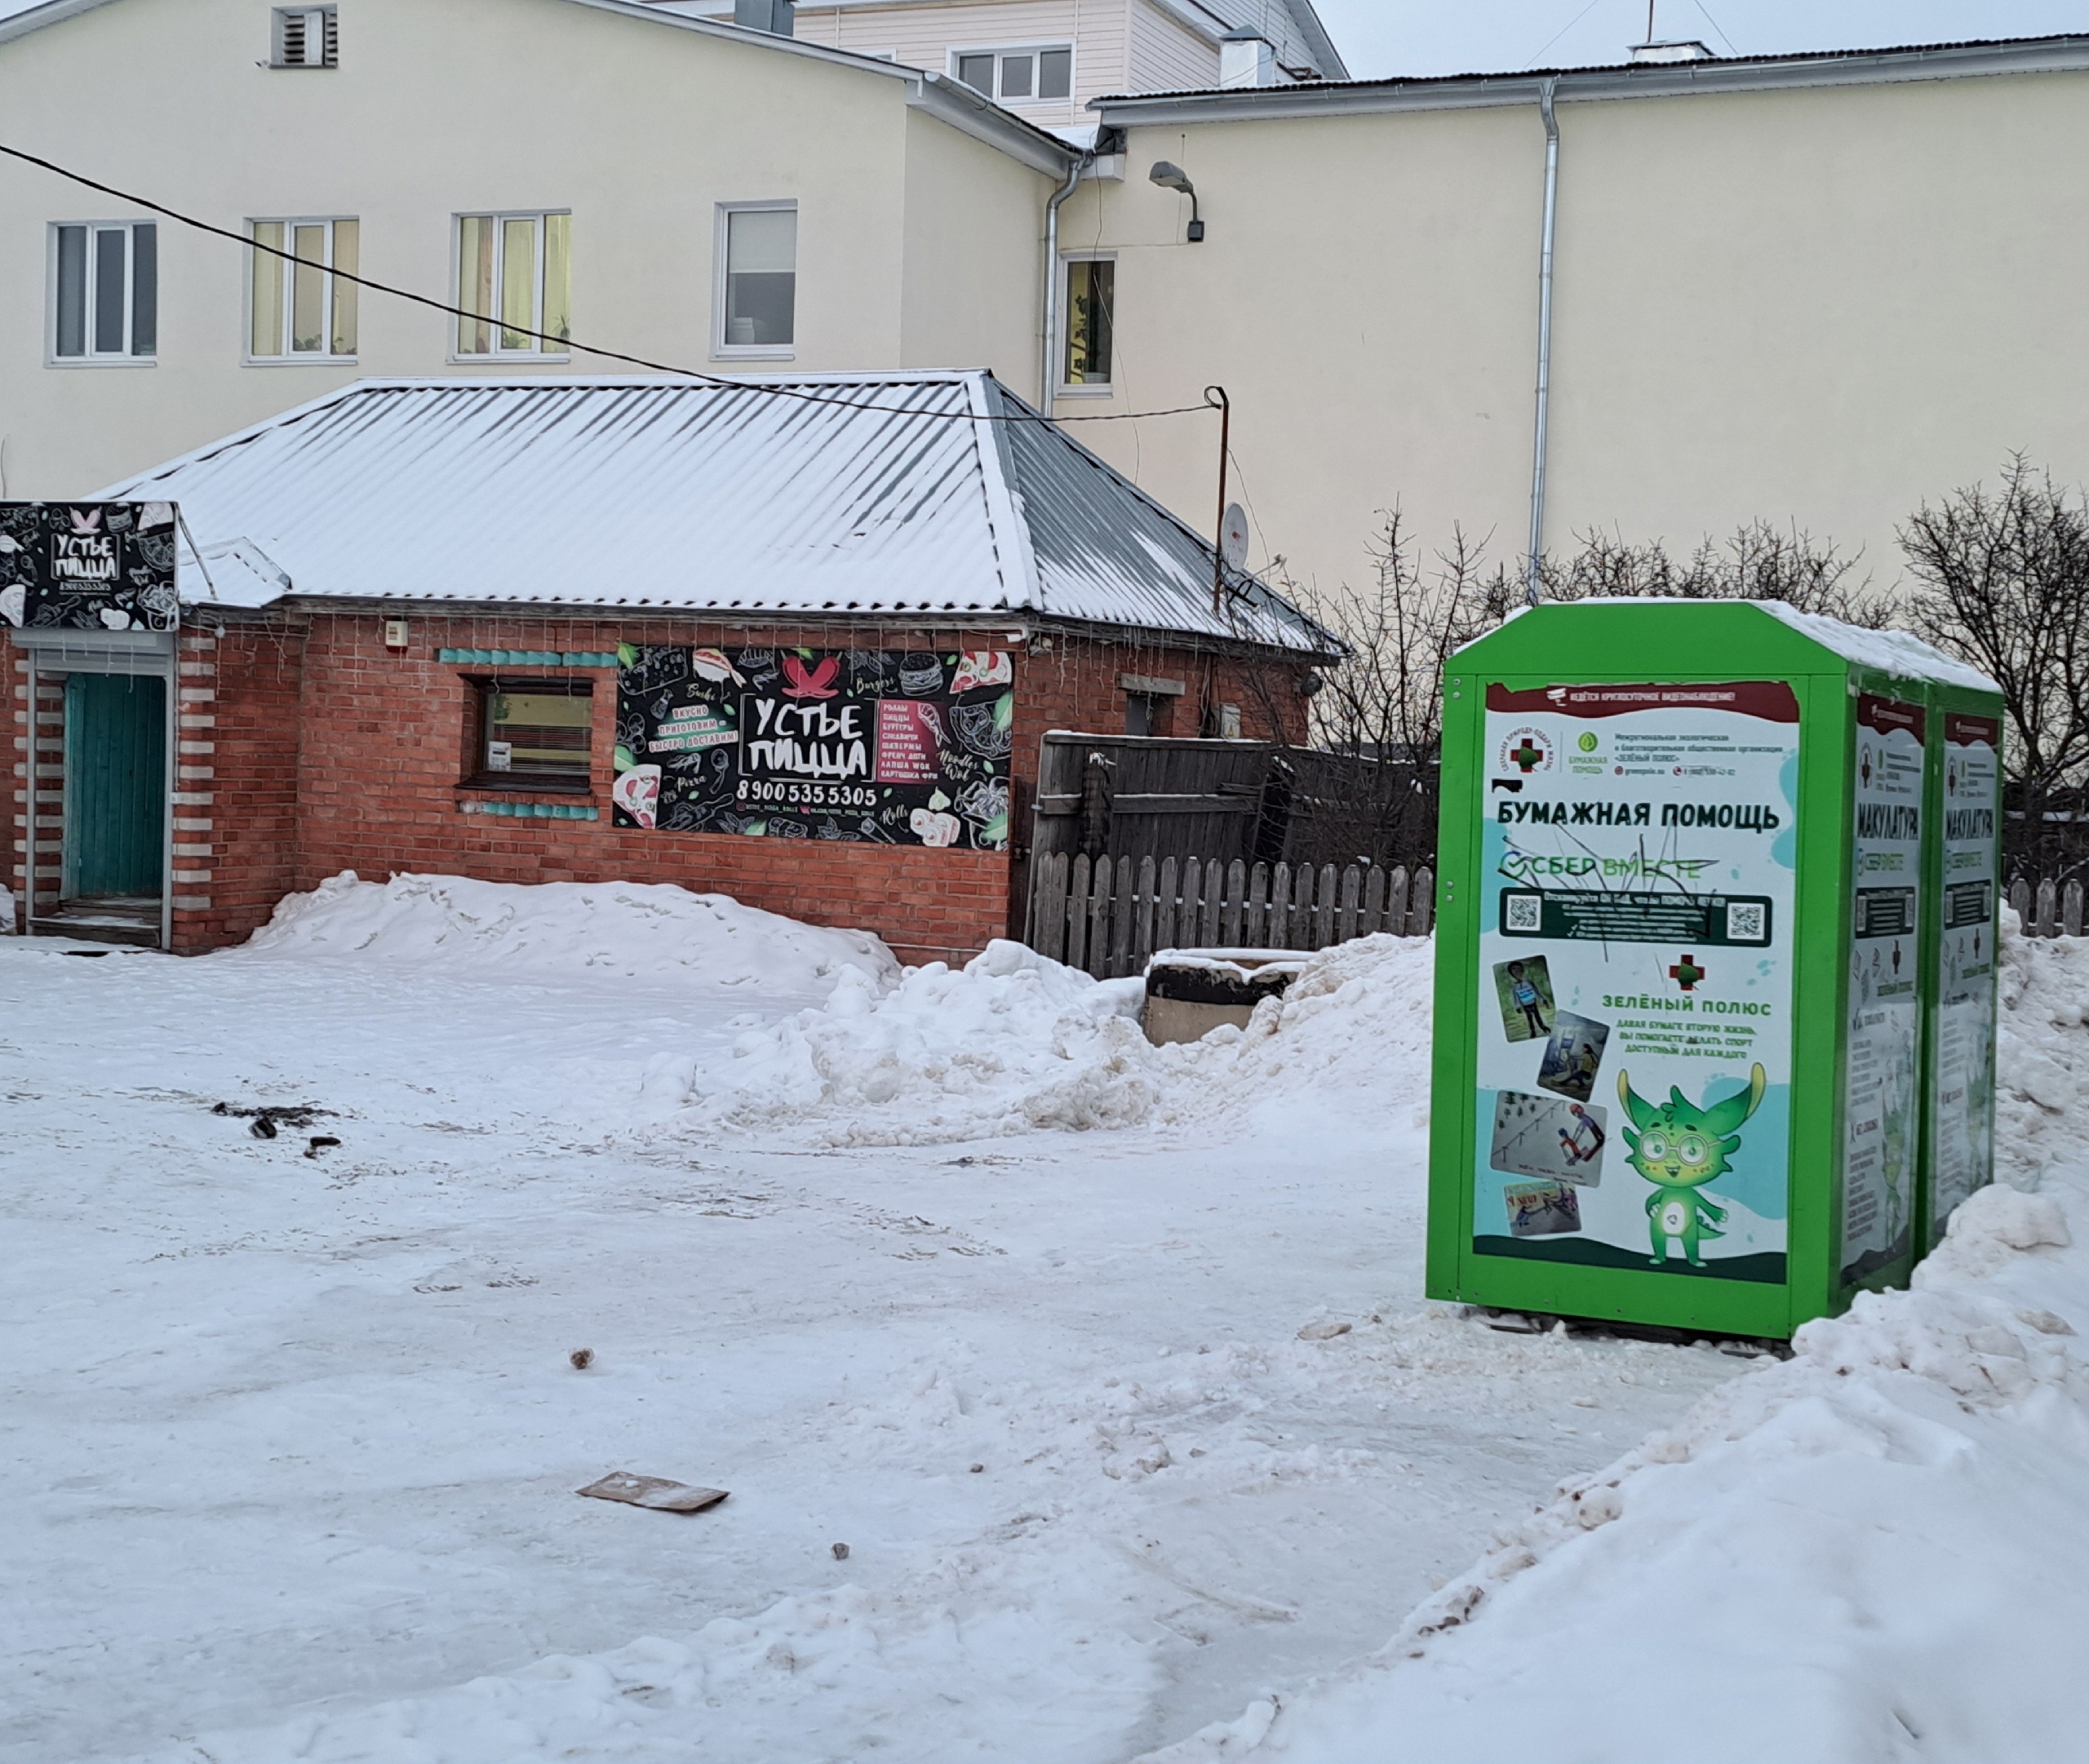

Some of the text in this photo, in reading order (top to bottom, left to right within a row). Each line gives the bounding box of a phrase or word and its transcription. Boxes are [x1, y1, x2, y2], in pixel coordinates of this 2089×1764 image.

[57, 534, 113, 557] УСТЬЕ
[54, 556, 116, 580] ПИЦЦА
[673, 705, 708, 719] ВКУСНО
[755, 698, 863, 739] УСТЬЕ
[650, 738, 685, 751] БЫСТРО
[746, 738, 867, 780] ПИЦЦА
[737, 779, 877, 806] 8 900 535 5305
[1497, 801, 1781, 834] БУМАЖНАЯ ПОМОЩЬ
[1857, 803, 1918, 840] МАКУЛАТУРА
[1603, 858, 1701, 879] ВМЕСТЕ
[1602, 994, 1772, 1016] ЗЕЛЁНЫЙ ПОЛЮС
[1617, 1019, 1646, 1028] ДАВАЯ
[1685, 1022, 1720, 1032] ВТОРУЮ
[1724, 1038, 1754, 1047] СПОРТ
